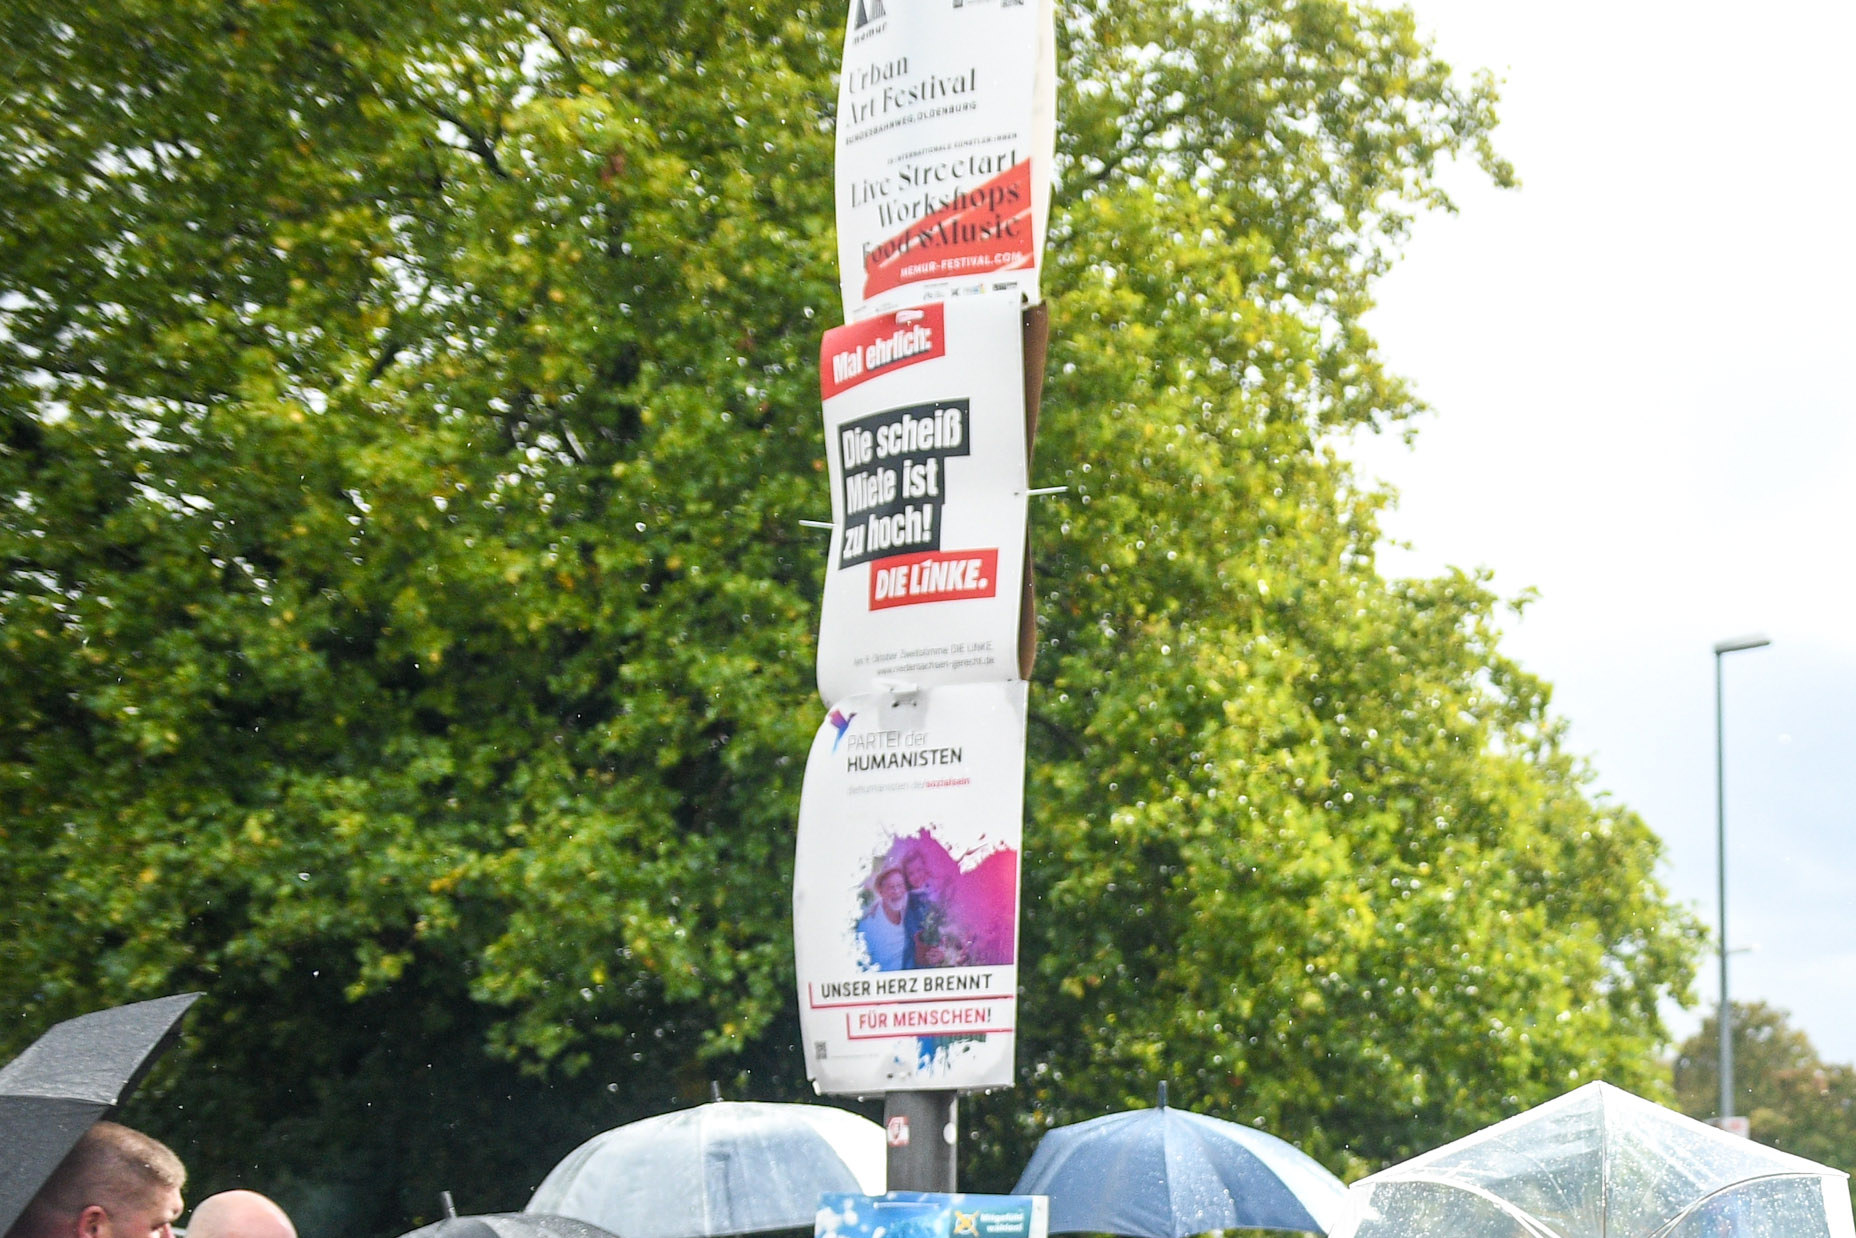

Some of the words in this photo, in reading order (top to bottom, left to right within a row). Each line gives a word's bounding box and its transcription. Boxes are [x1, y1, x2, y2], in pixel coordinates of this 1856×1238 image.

[849, 57, 908, 94] Urban
[846, 98, 875, 128] Art
[883, 67, 976, 112] Festival
[917, 101, 976, 121] OLDENBURG
[851, 178, 890, 208] Live
[899, 149, 1017, 191] Streetart
[878, 182, 1021, 228] Workshops
[863, 229, 910, 269] Food
[833, 345, 863, 385] Mal
[865, 324, 933, 370] ehrlich:
[842, 426, 873, 470] Die
[876, 408, 962, 458] scheiß
[846, 467, 897, 515] Miete
[902, 457, 939, 498] ist
[843, 524, 866, 559] zu
[867, 503, 933, 552] hoch!
[875, 565, 909, 600] DIE
[847, 731, 900, 751] PARTEI
[905, 732, 928, 747] der
[847, 747, 962, 773] HUMANISTEN
[821, 980, 871, 998] UNSER
[876, 977, 918, 994] HERZ
[923, 974, 992, 992] BRENNT
[859, 1010, 887, 1029] FÜR
[893, 1008, 991, 1027] MENSCHEN!
